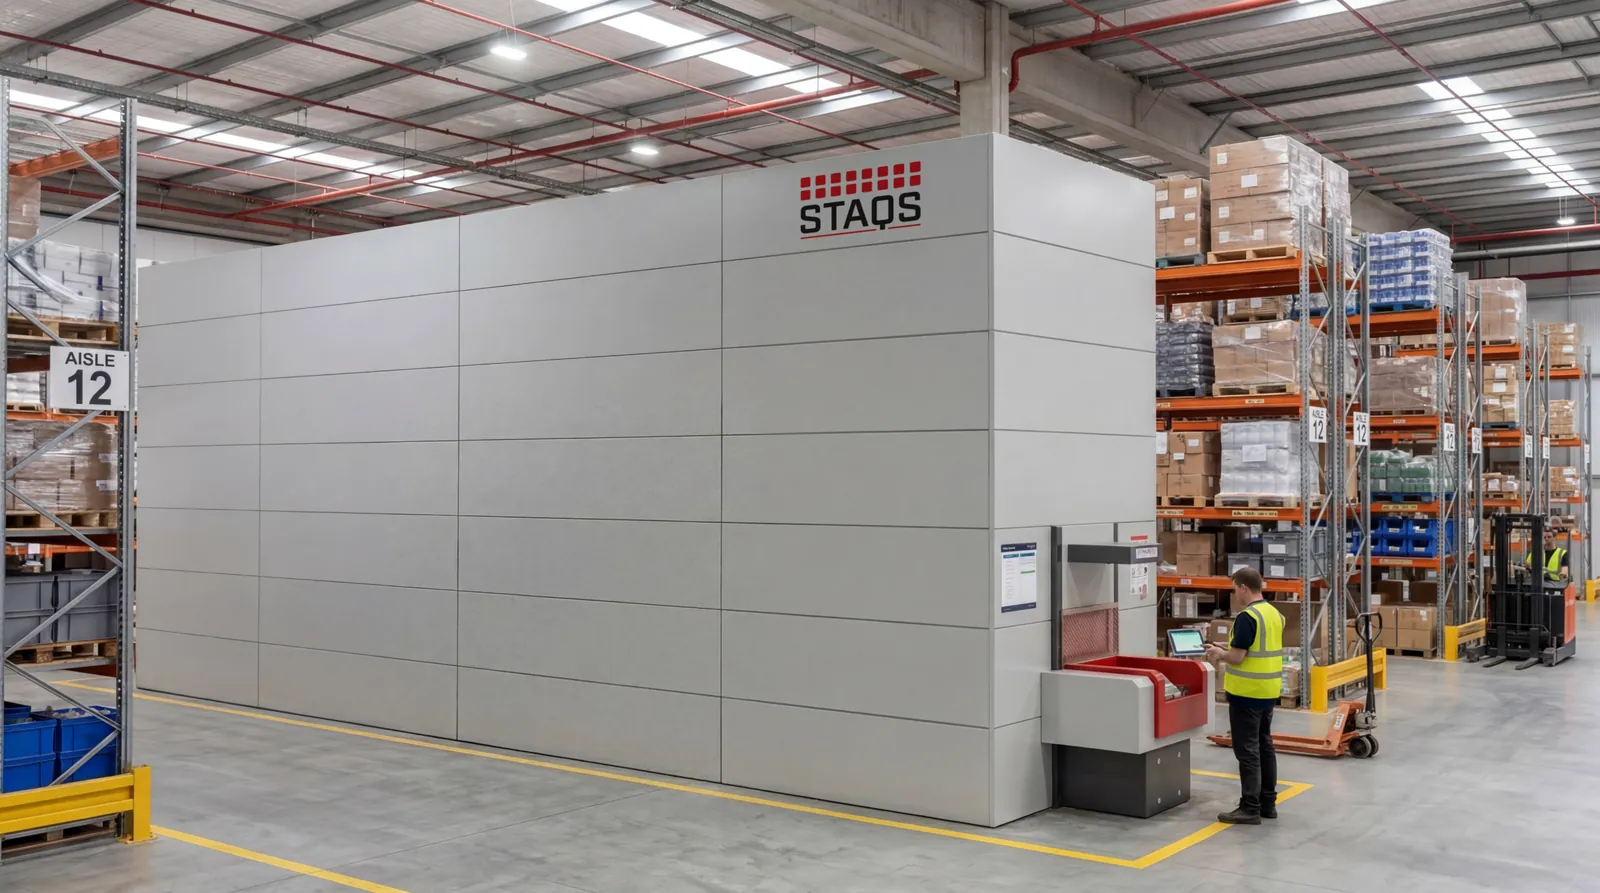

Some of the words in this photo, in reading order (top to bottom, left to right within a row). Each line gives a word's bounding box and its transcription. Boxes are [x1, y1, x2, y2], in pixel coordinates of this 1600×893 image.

[800, 191, 921, 234] STAQS
[65, 351, 115, 367] AISLE
[68, 369, 111, 405] 12
[1313, 420, 1323, 440] 12
[1356, 424, 1366, 442] 12
